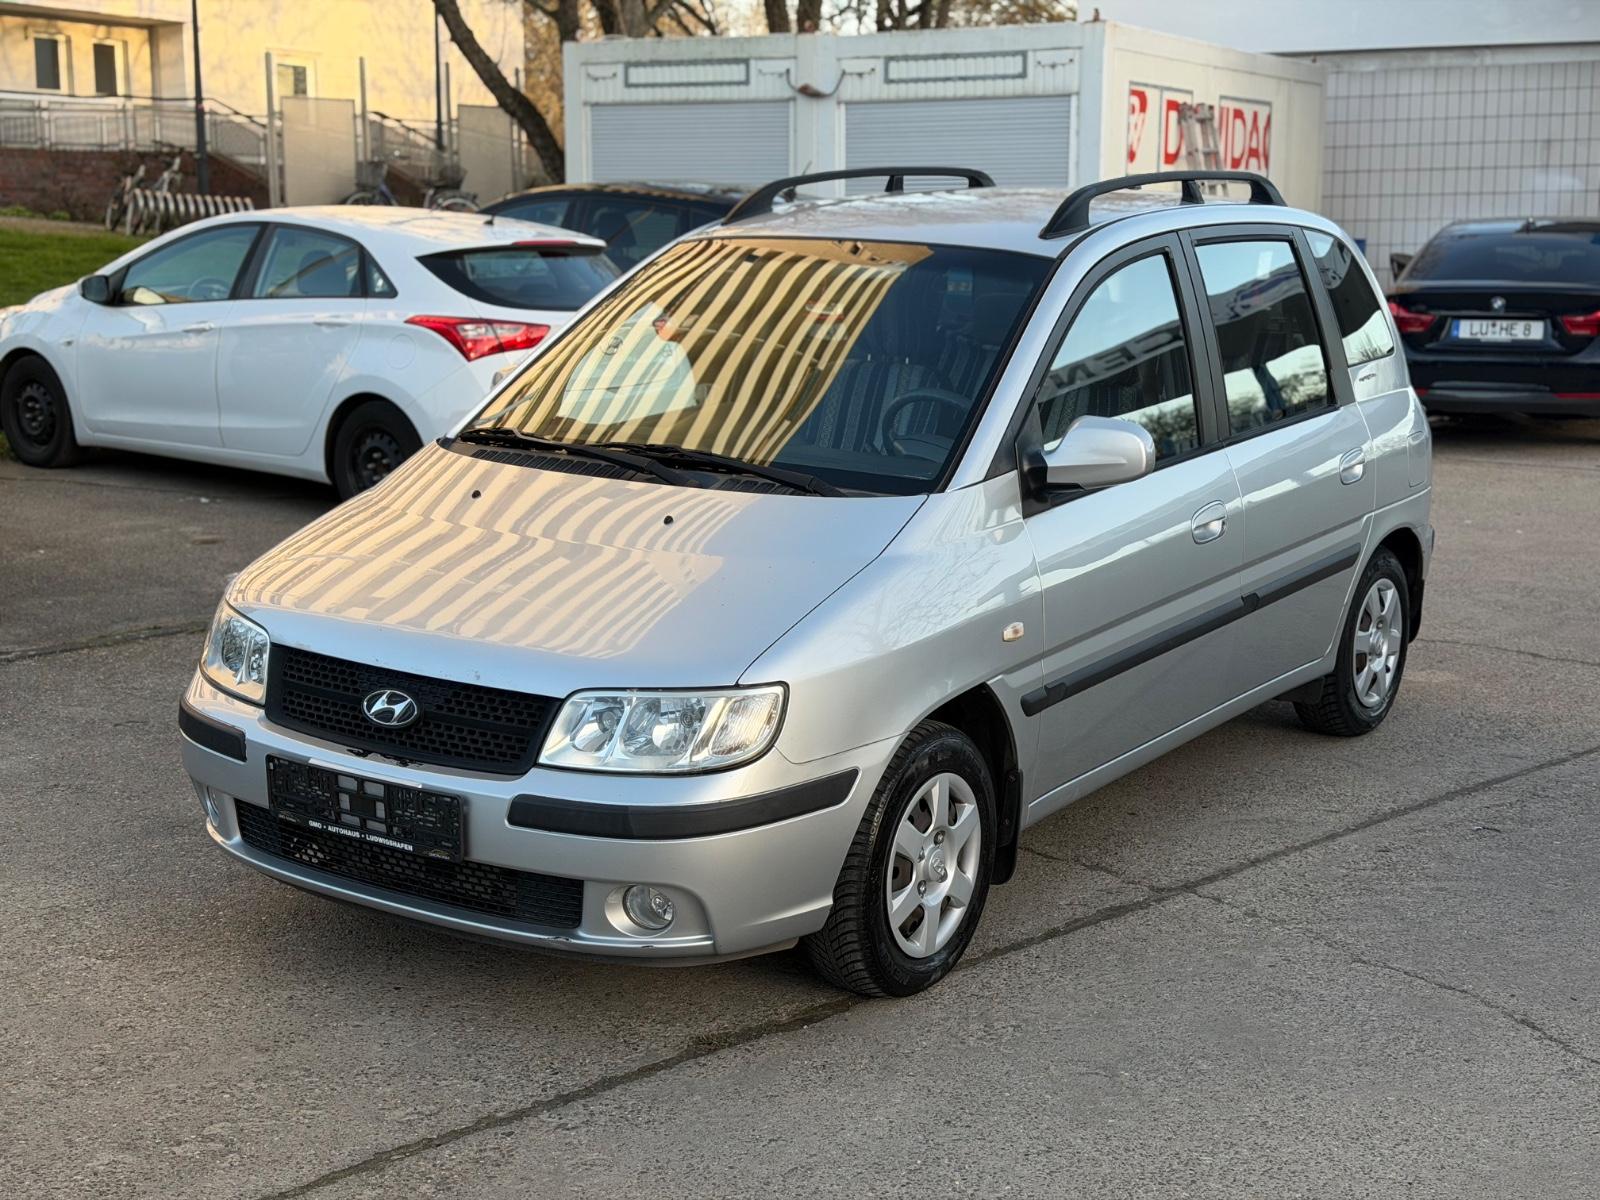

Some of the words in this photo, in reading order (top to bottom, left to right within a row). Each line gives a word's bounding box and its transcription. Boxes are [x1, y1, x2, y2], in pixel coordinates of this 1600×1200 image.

[1469, 321, 1489, 336] LU
[1523, 323, 1532, 337] 8
[328, 825, 360, 839] AUTOHAUS
[365, 834, 413, 852] LUDWIGSHAFEN
